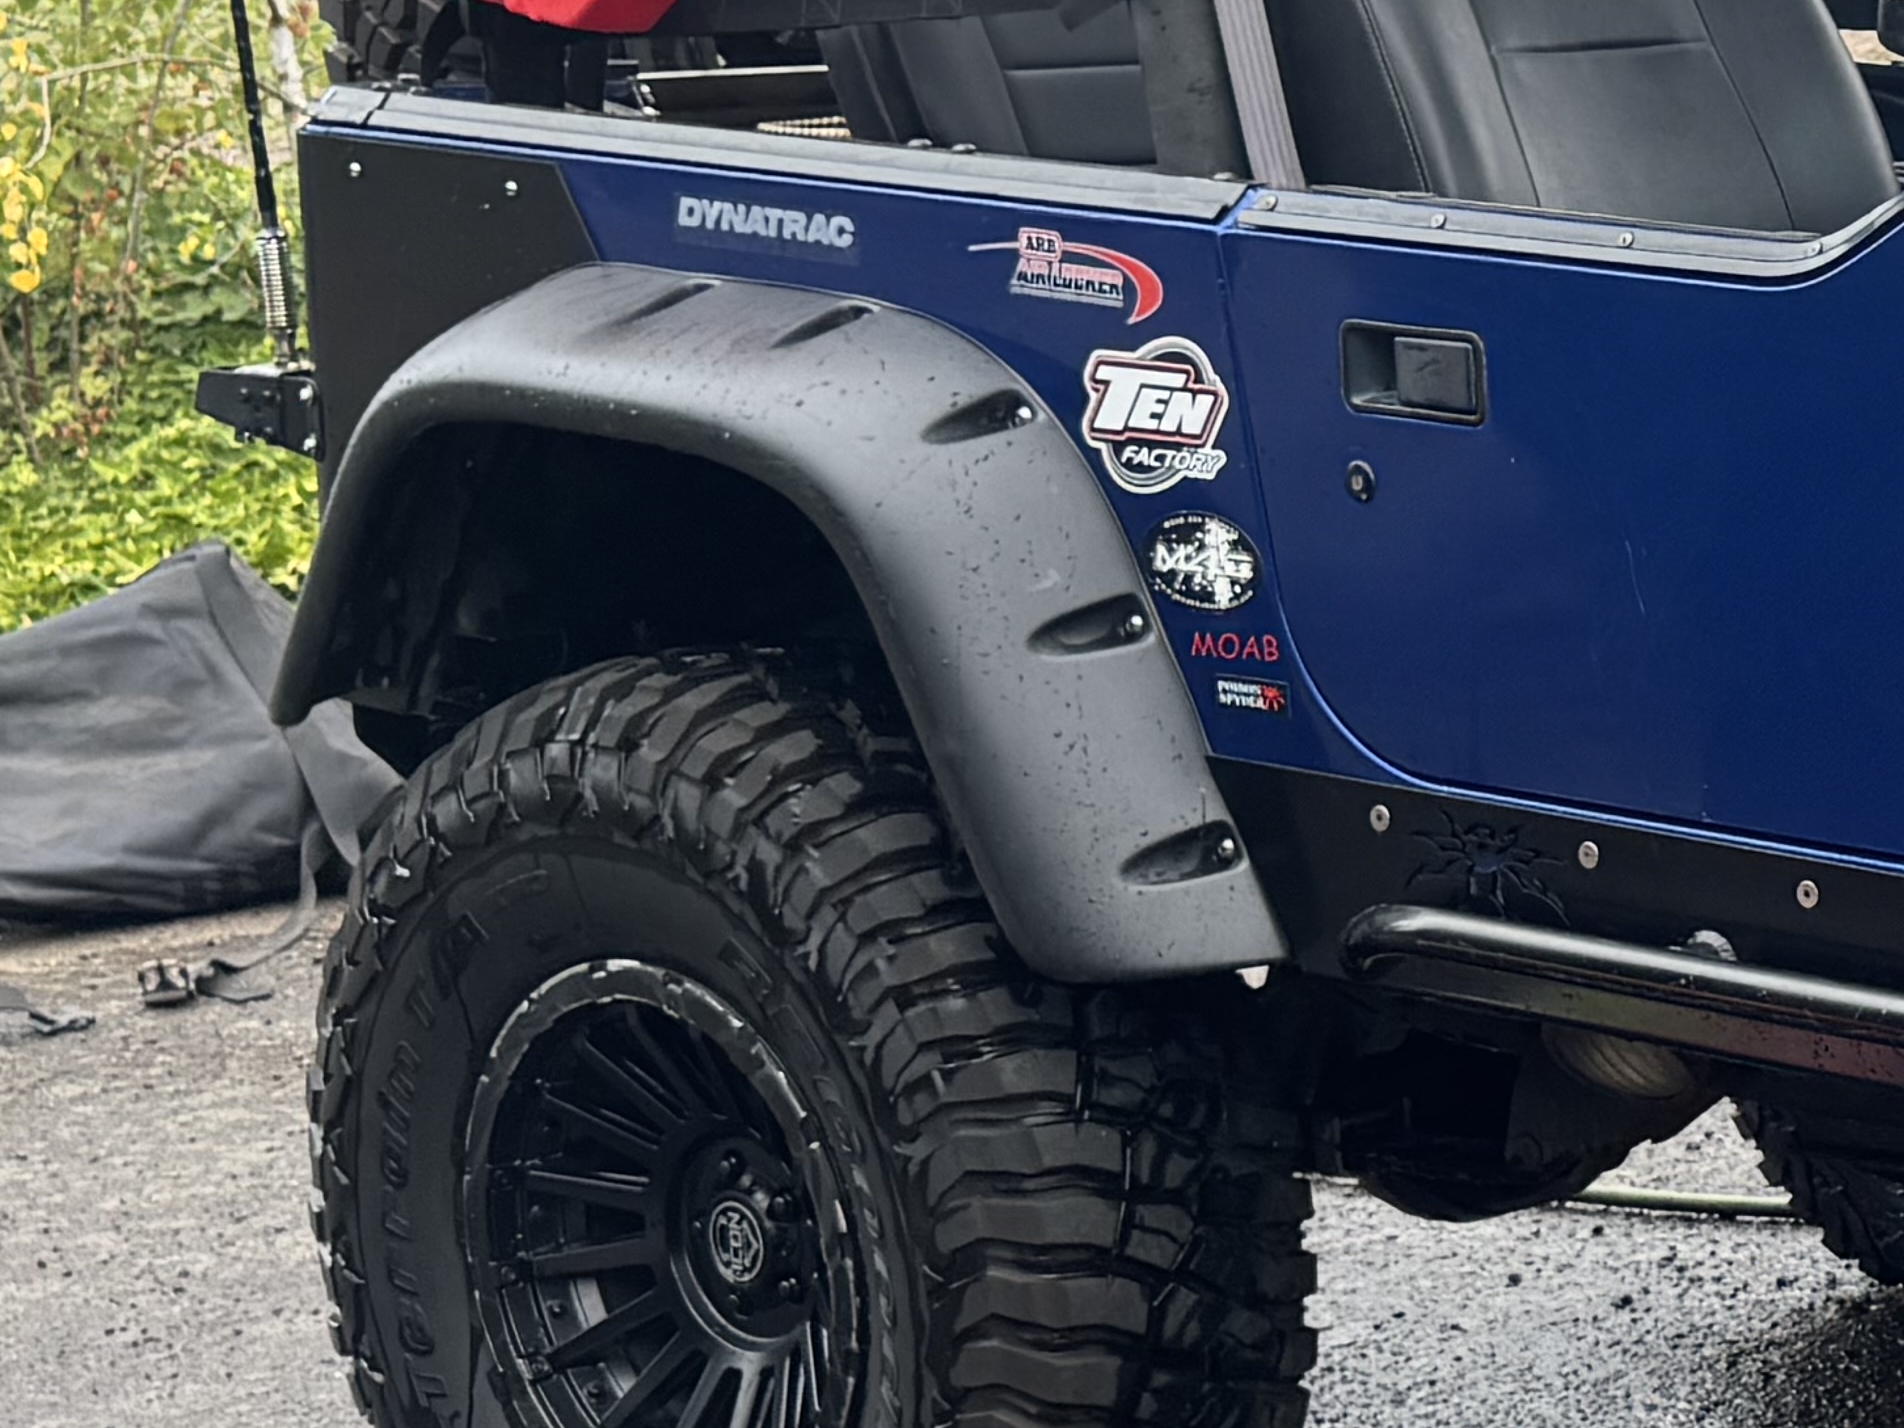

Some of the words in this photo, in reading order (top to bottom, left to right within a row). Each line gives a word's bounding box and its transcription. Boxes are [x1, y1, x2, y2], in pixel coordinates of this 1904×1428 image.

[677, 195, 856, 248] DYNATRAC
[1025, 235, 1057, 254] ARB
[1121, 445, 1220, 471] FACTORY
[1191, 631, 1280, 662] MOAB
